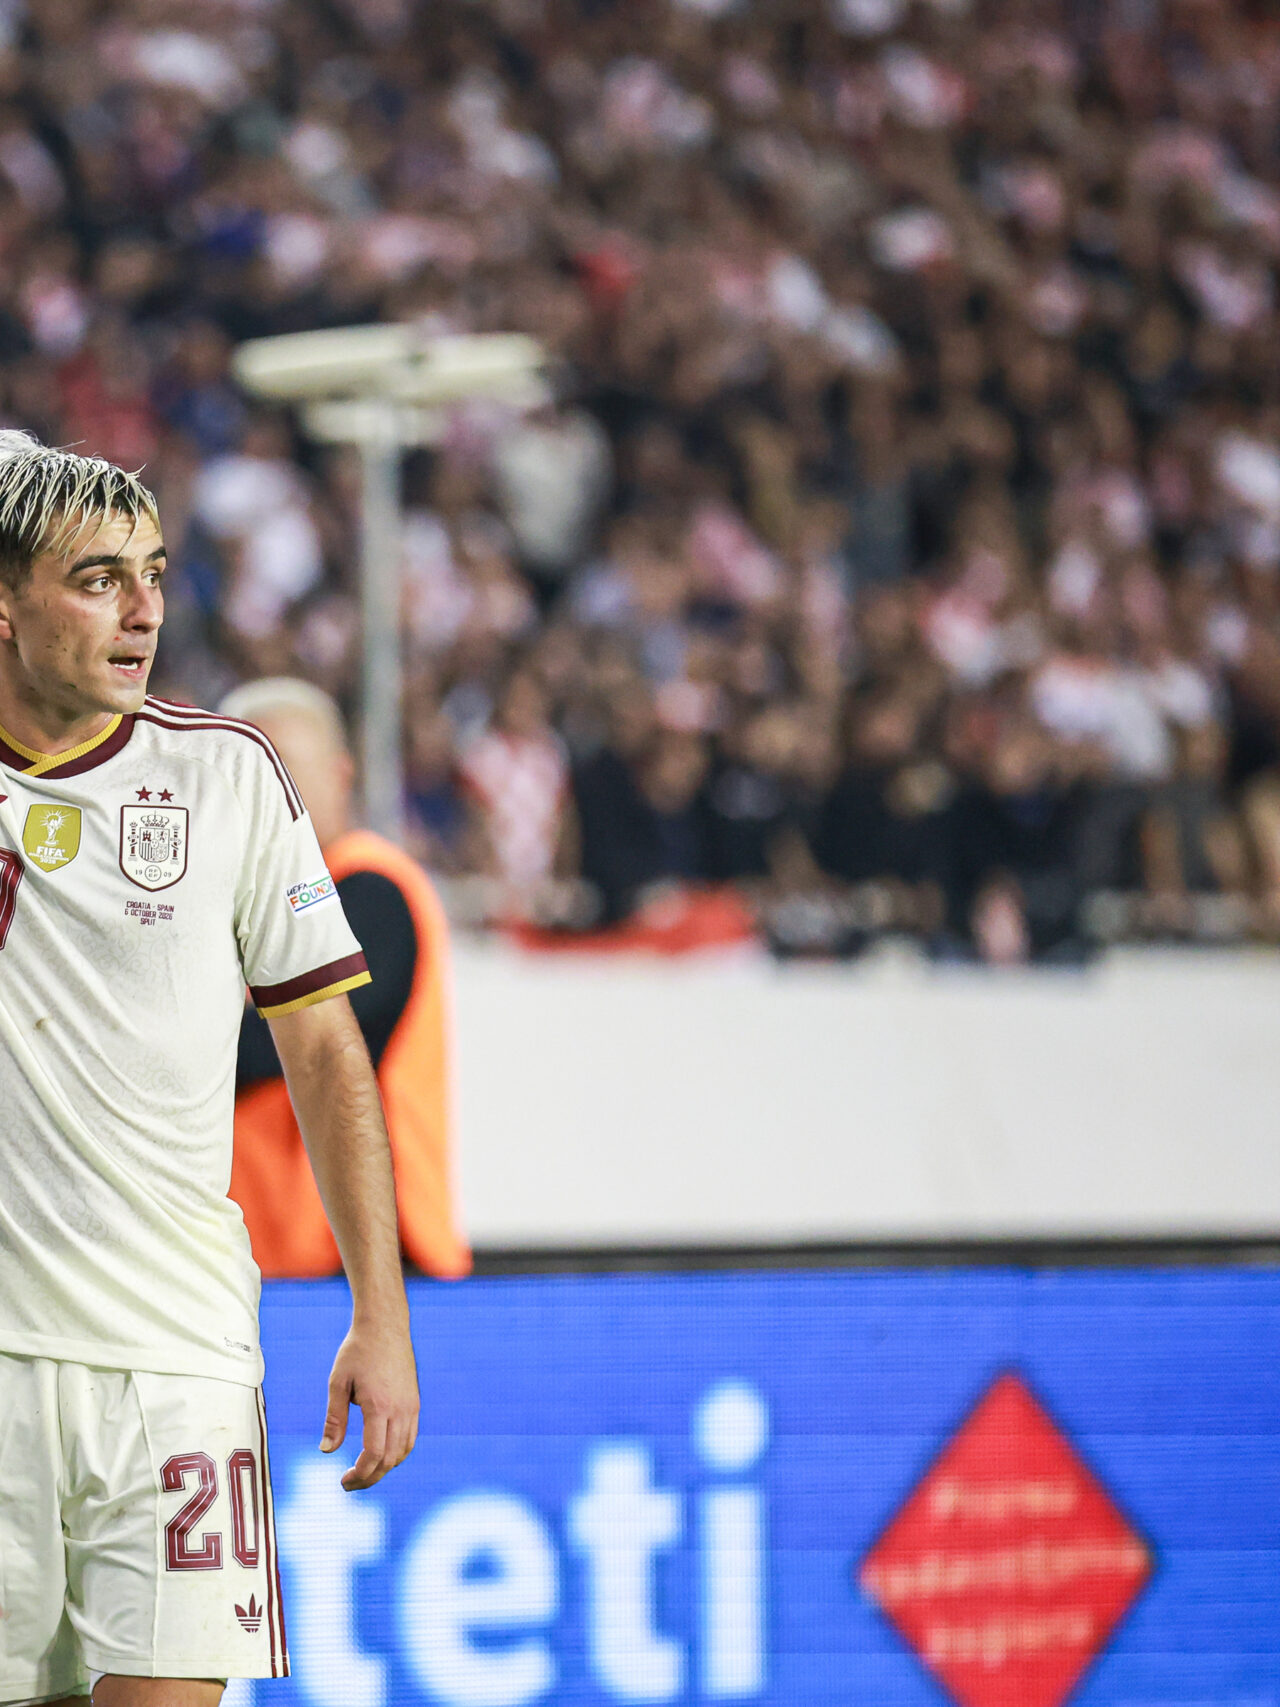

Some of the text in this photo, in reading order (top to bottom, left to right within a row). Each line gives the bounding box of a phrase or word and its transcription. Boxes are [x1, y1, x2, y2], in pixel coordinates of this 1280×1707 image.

[36, 845, 63, 858] FIFA
[286, 883, 308, 897] UEFA
[124, 908, 129, 916] 6
[130, 909, 157, 918] OCTOBER
[126, 900, 151, 910] CROATIA
[157, 903, 175, 913] SPAIN
[140, 917, 156, 926] SPLIT
[161, 1450, 258, 1572] 20
